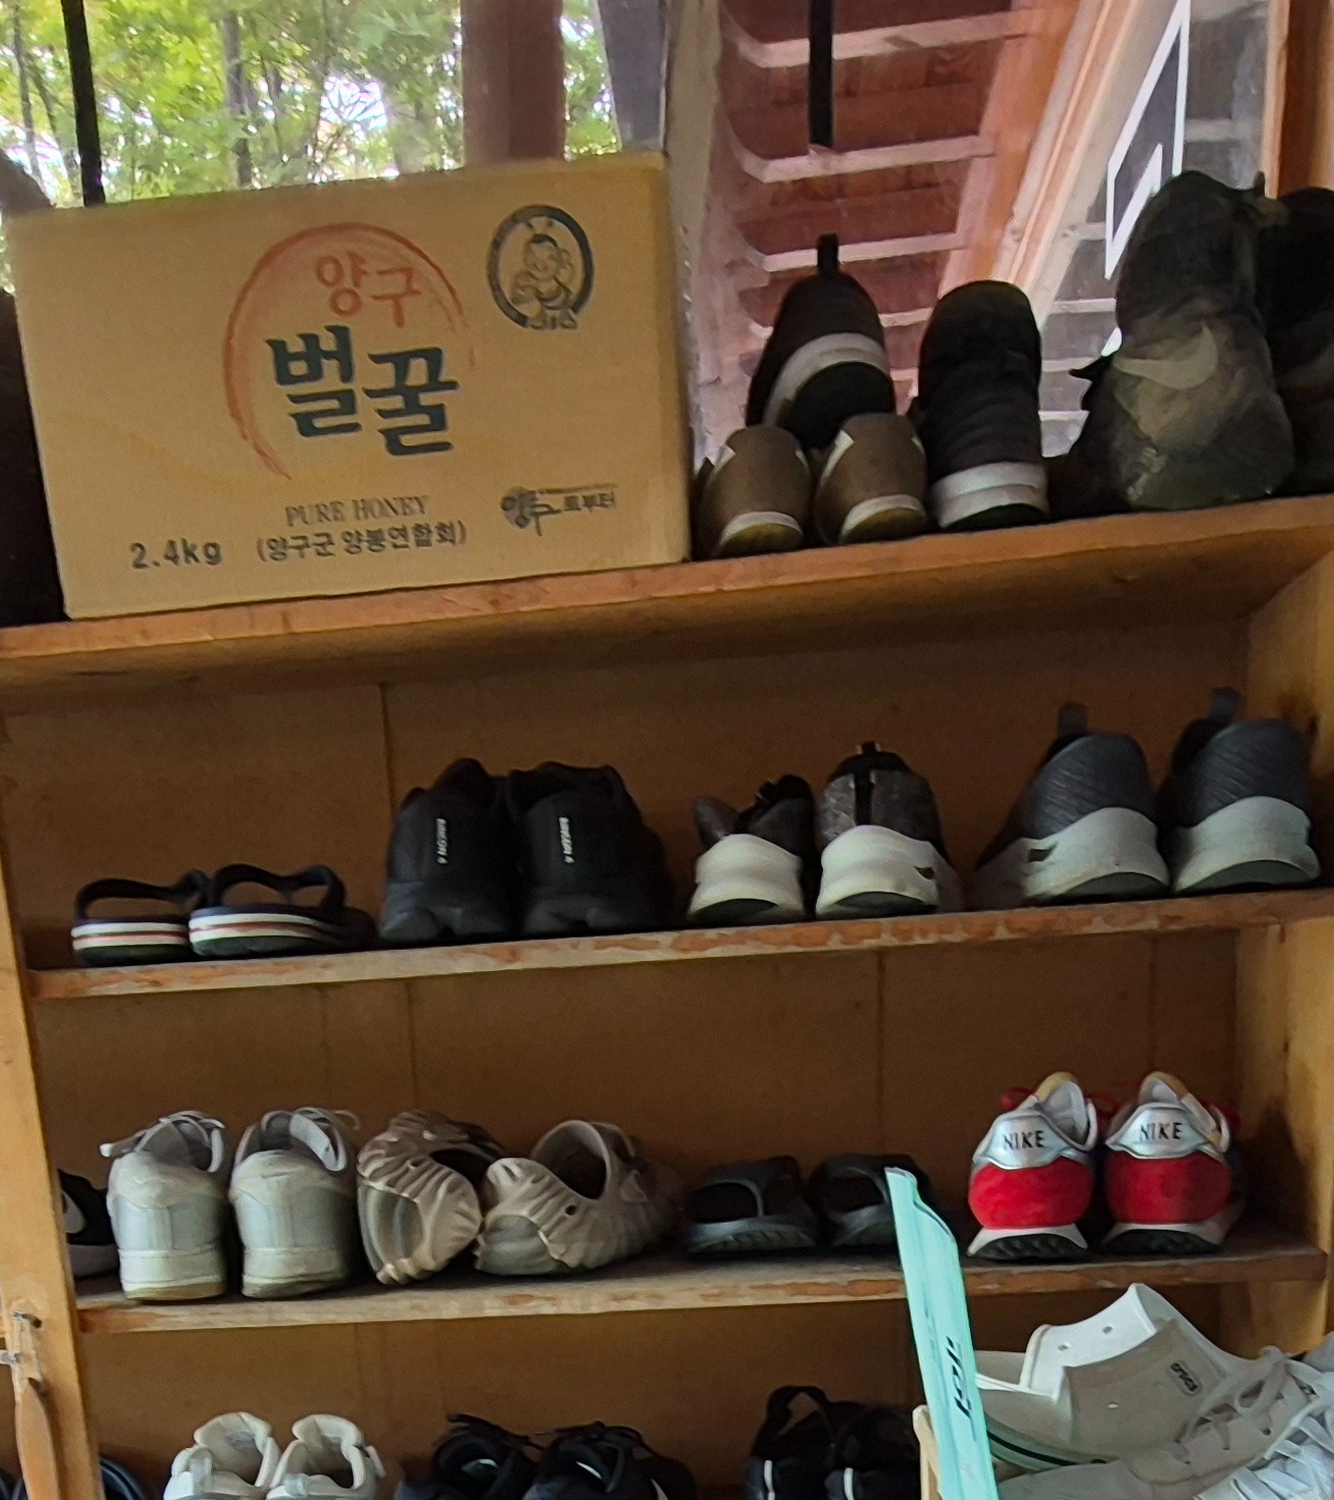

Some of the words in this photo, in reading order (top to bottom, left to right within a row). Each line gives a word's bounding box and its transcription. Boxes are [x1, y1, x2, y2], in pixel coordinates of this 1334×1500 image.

[317, 250, 421, 329] 양구
[266, 323, 460, 456] 벌꿀
[286, 499, 345, 527] PURE
[354, 494, 430, 519] HONEY
[130, 537, 223, 570] 2.4kg
[257, 531, 336, 562] (양구군
[1004, 1130, 1045, 1151] NIKE
[1140, 1121, 1184, 1142] NIKE
